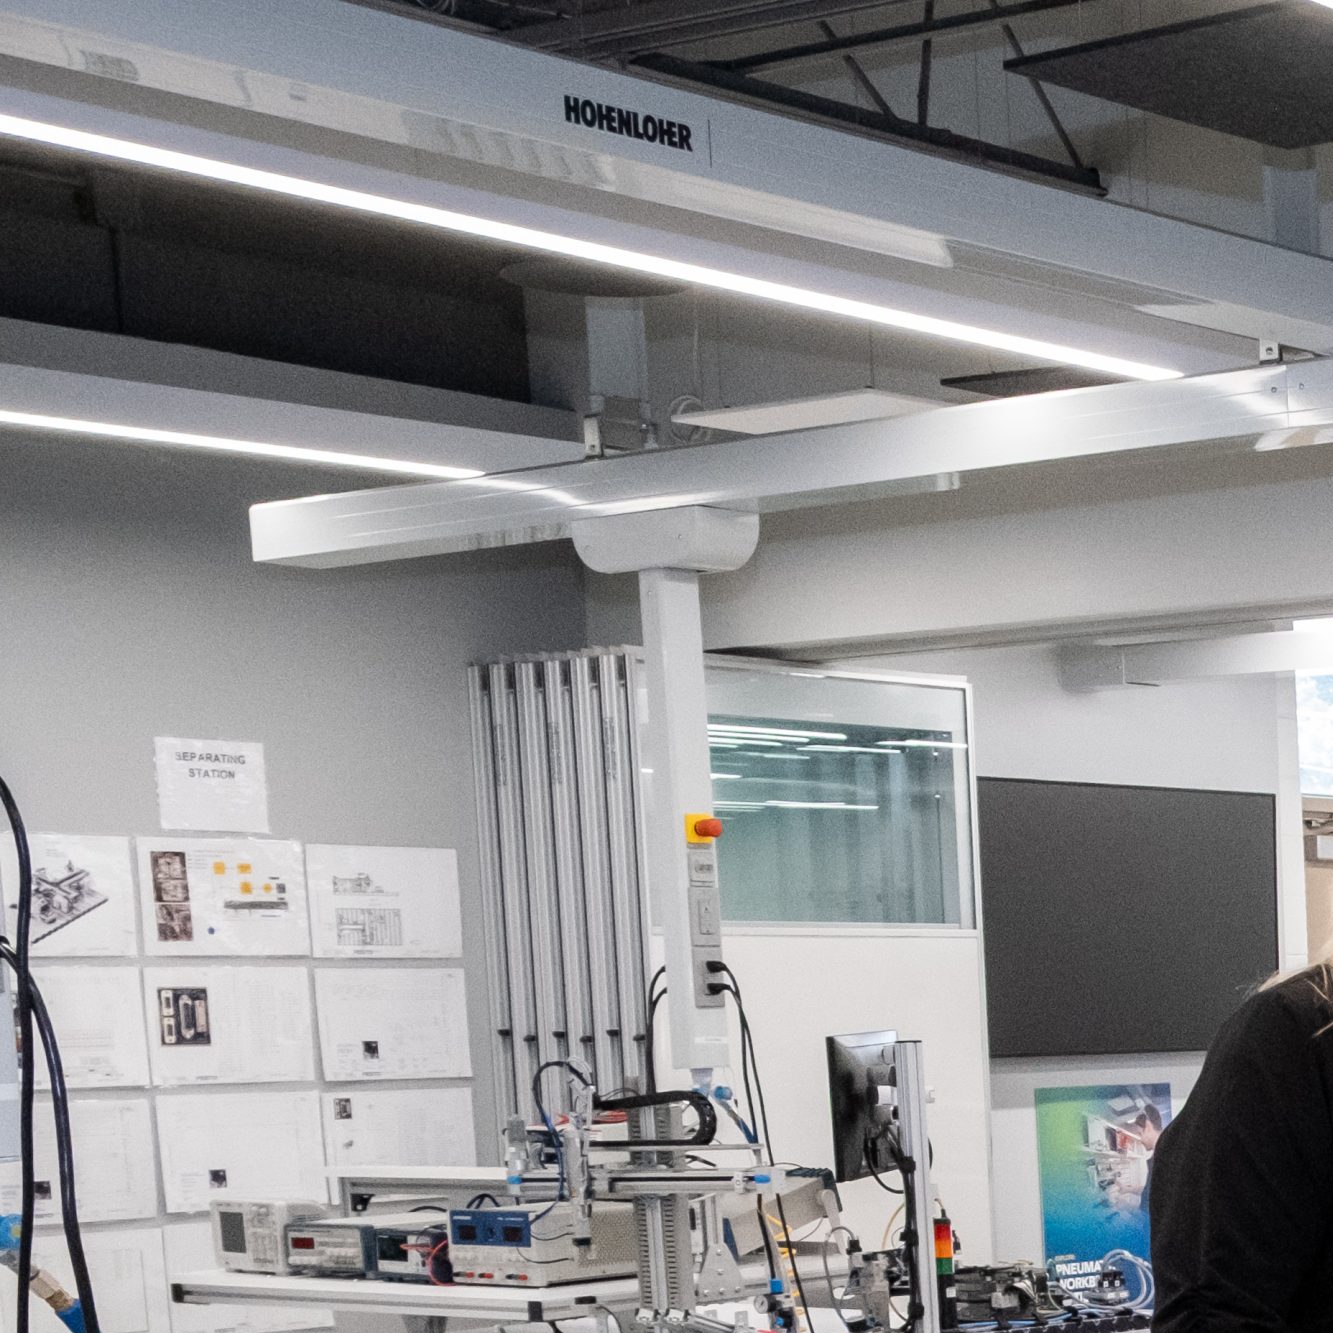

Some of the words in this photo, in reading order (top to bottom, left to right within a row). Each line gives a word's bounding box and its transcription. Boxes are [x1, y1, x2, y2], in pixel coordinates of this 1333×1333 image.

[175, 751, 246, 765] SEPARATING
[188, 767, 236, 780] STATION
[1060, 1275, 1101, 1290] WORKB
